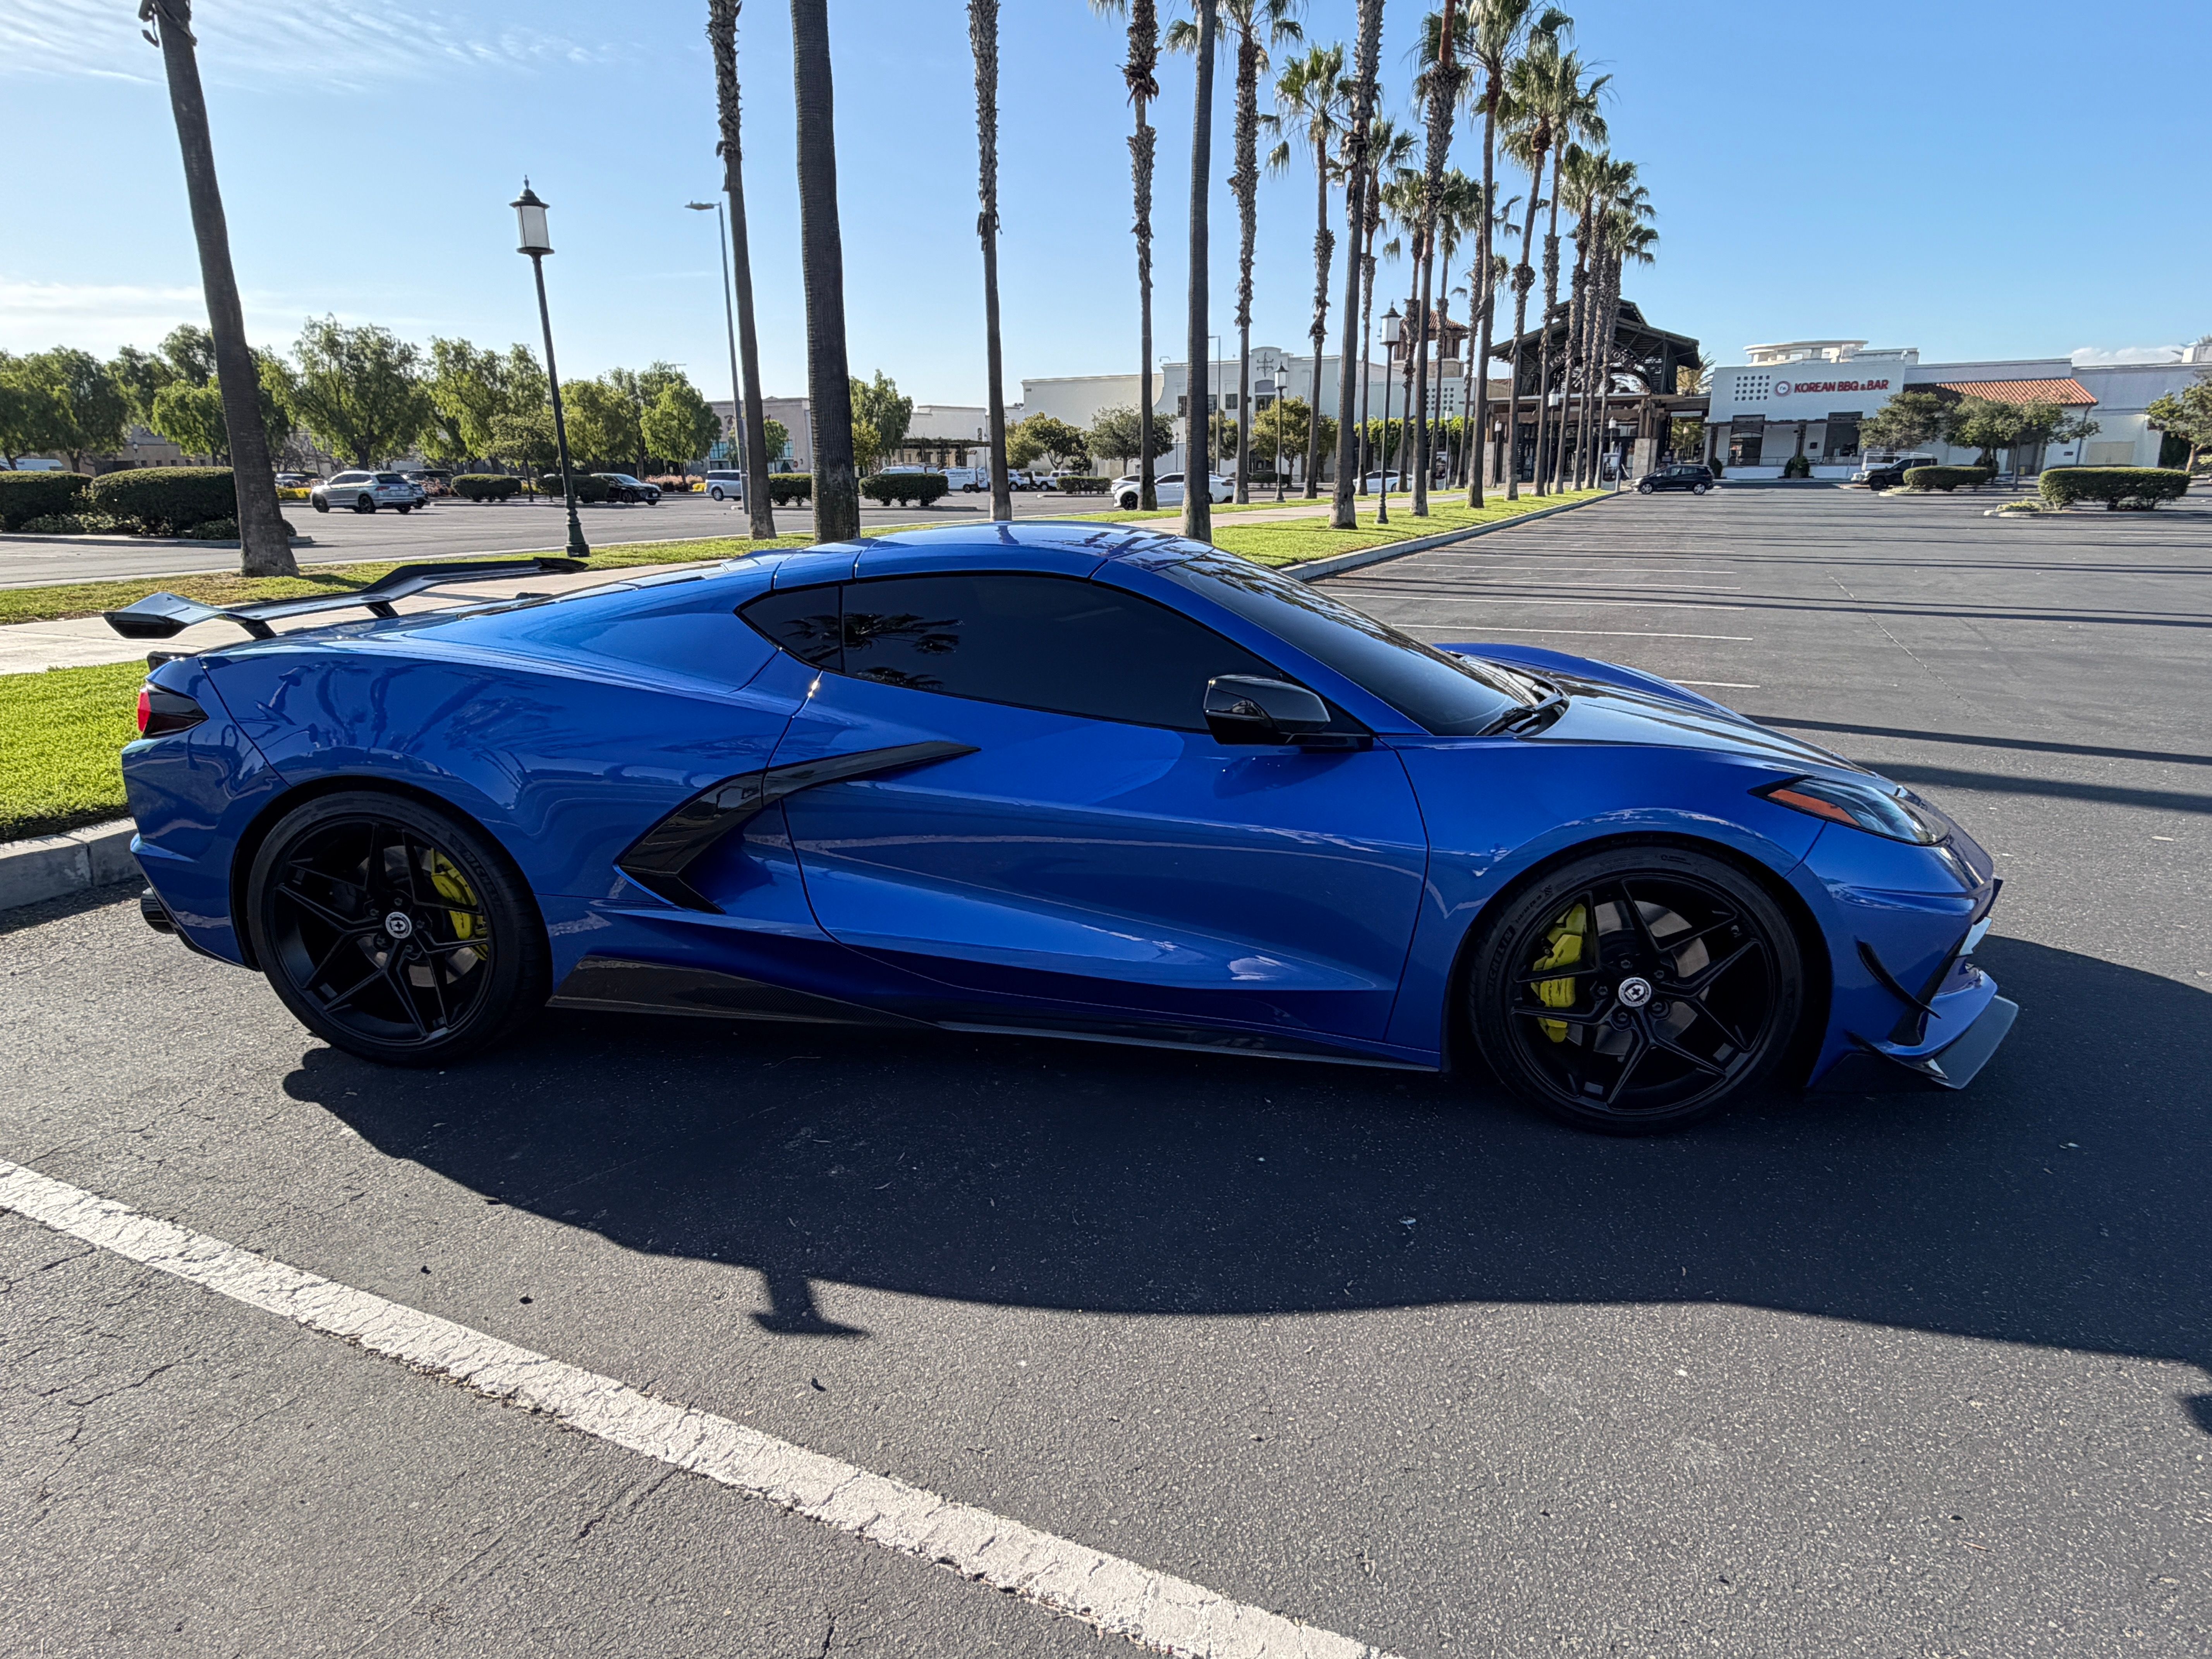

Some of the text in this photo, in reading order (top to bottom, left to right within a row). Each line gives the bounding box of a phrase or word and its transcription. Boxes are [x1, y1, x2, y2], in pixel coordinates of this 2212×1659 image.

[1794, 382, 1836, 393] KOREAN
[1837, 381, 1859, 392] BBQ
[1867, 379, 1889, 390] BAR
[1486, 930, 1513, 996] MICHELIN
